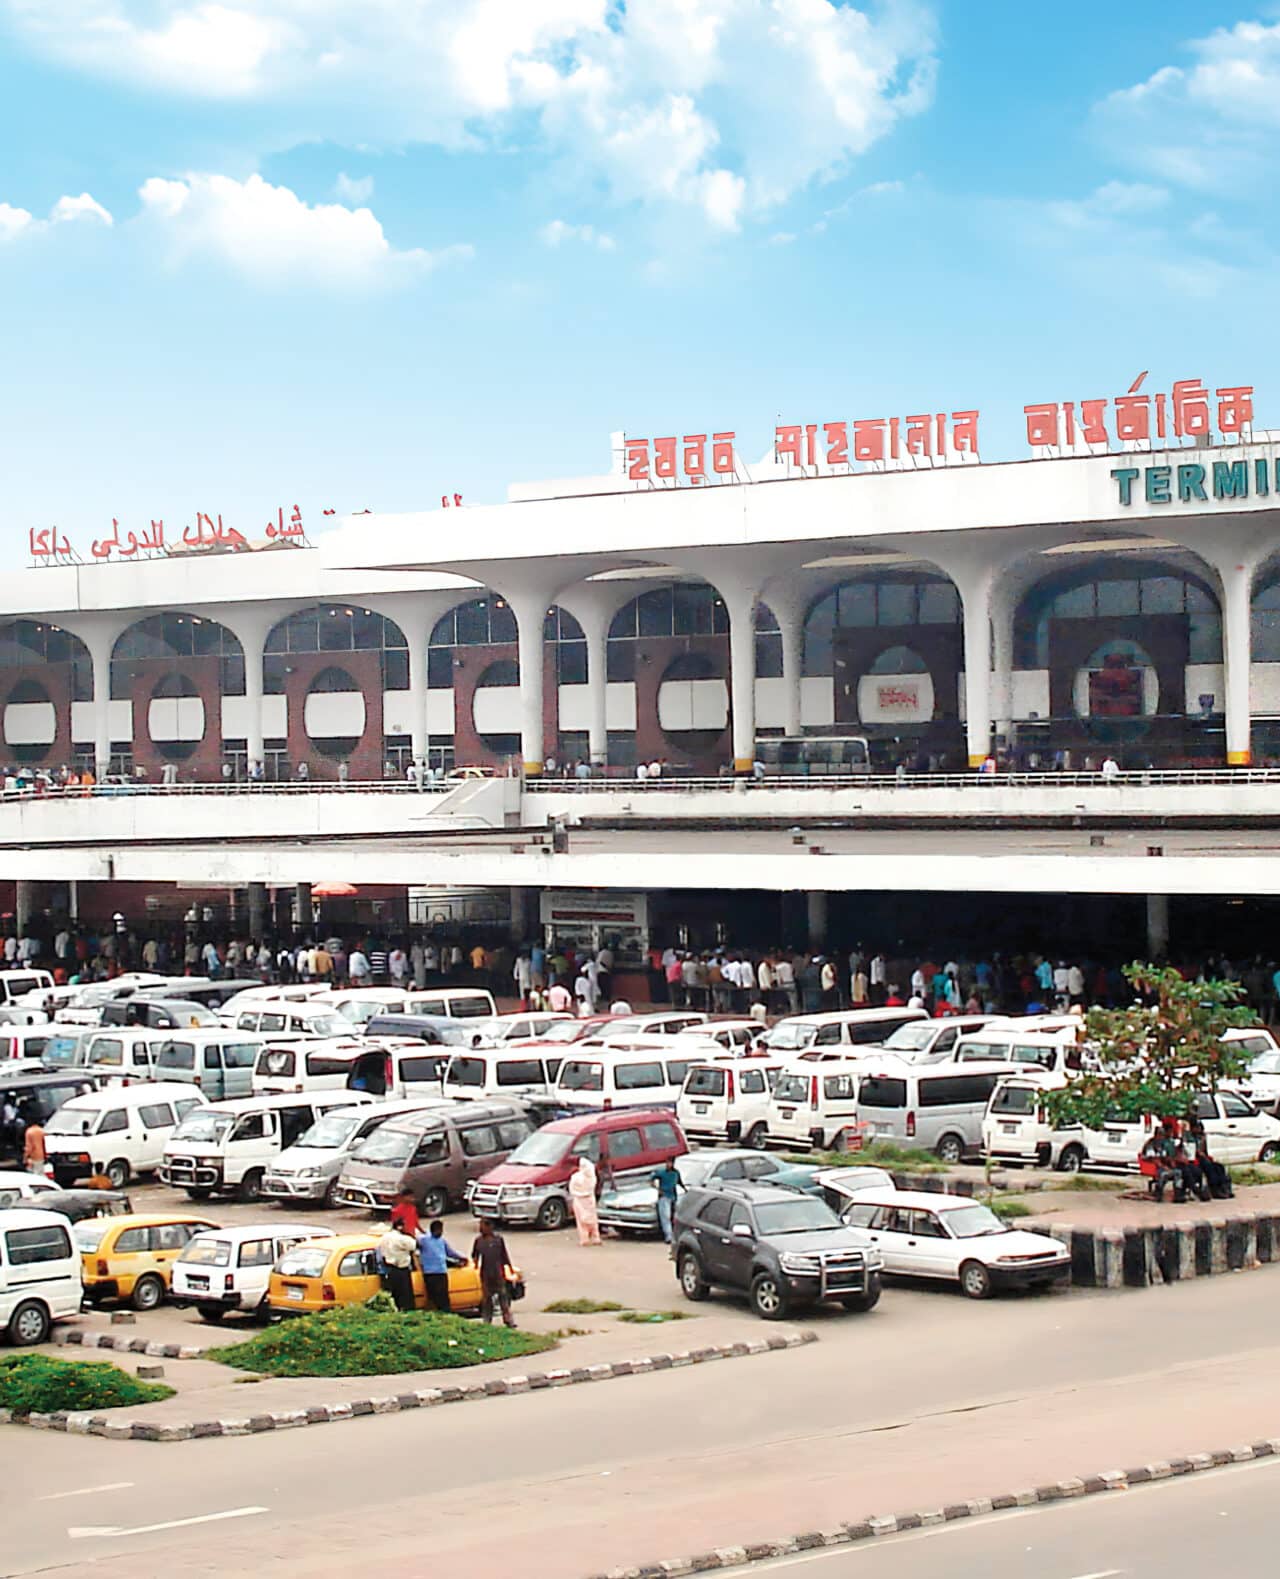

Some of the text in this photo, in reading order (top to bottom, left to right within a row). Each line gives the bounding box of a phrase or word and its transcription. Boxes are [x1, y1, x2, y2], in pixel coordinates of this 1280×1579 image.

[624, 432, 736, 484] হযরত
[776, 410, 980, 466] শাহজালাল
[1023, 370, 1253, 446] আন্তর্জাতিক
